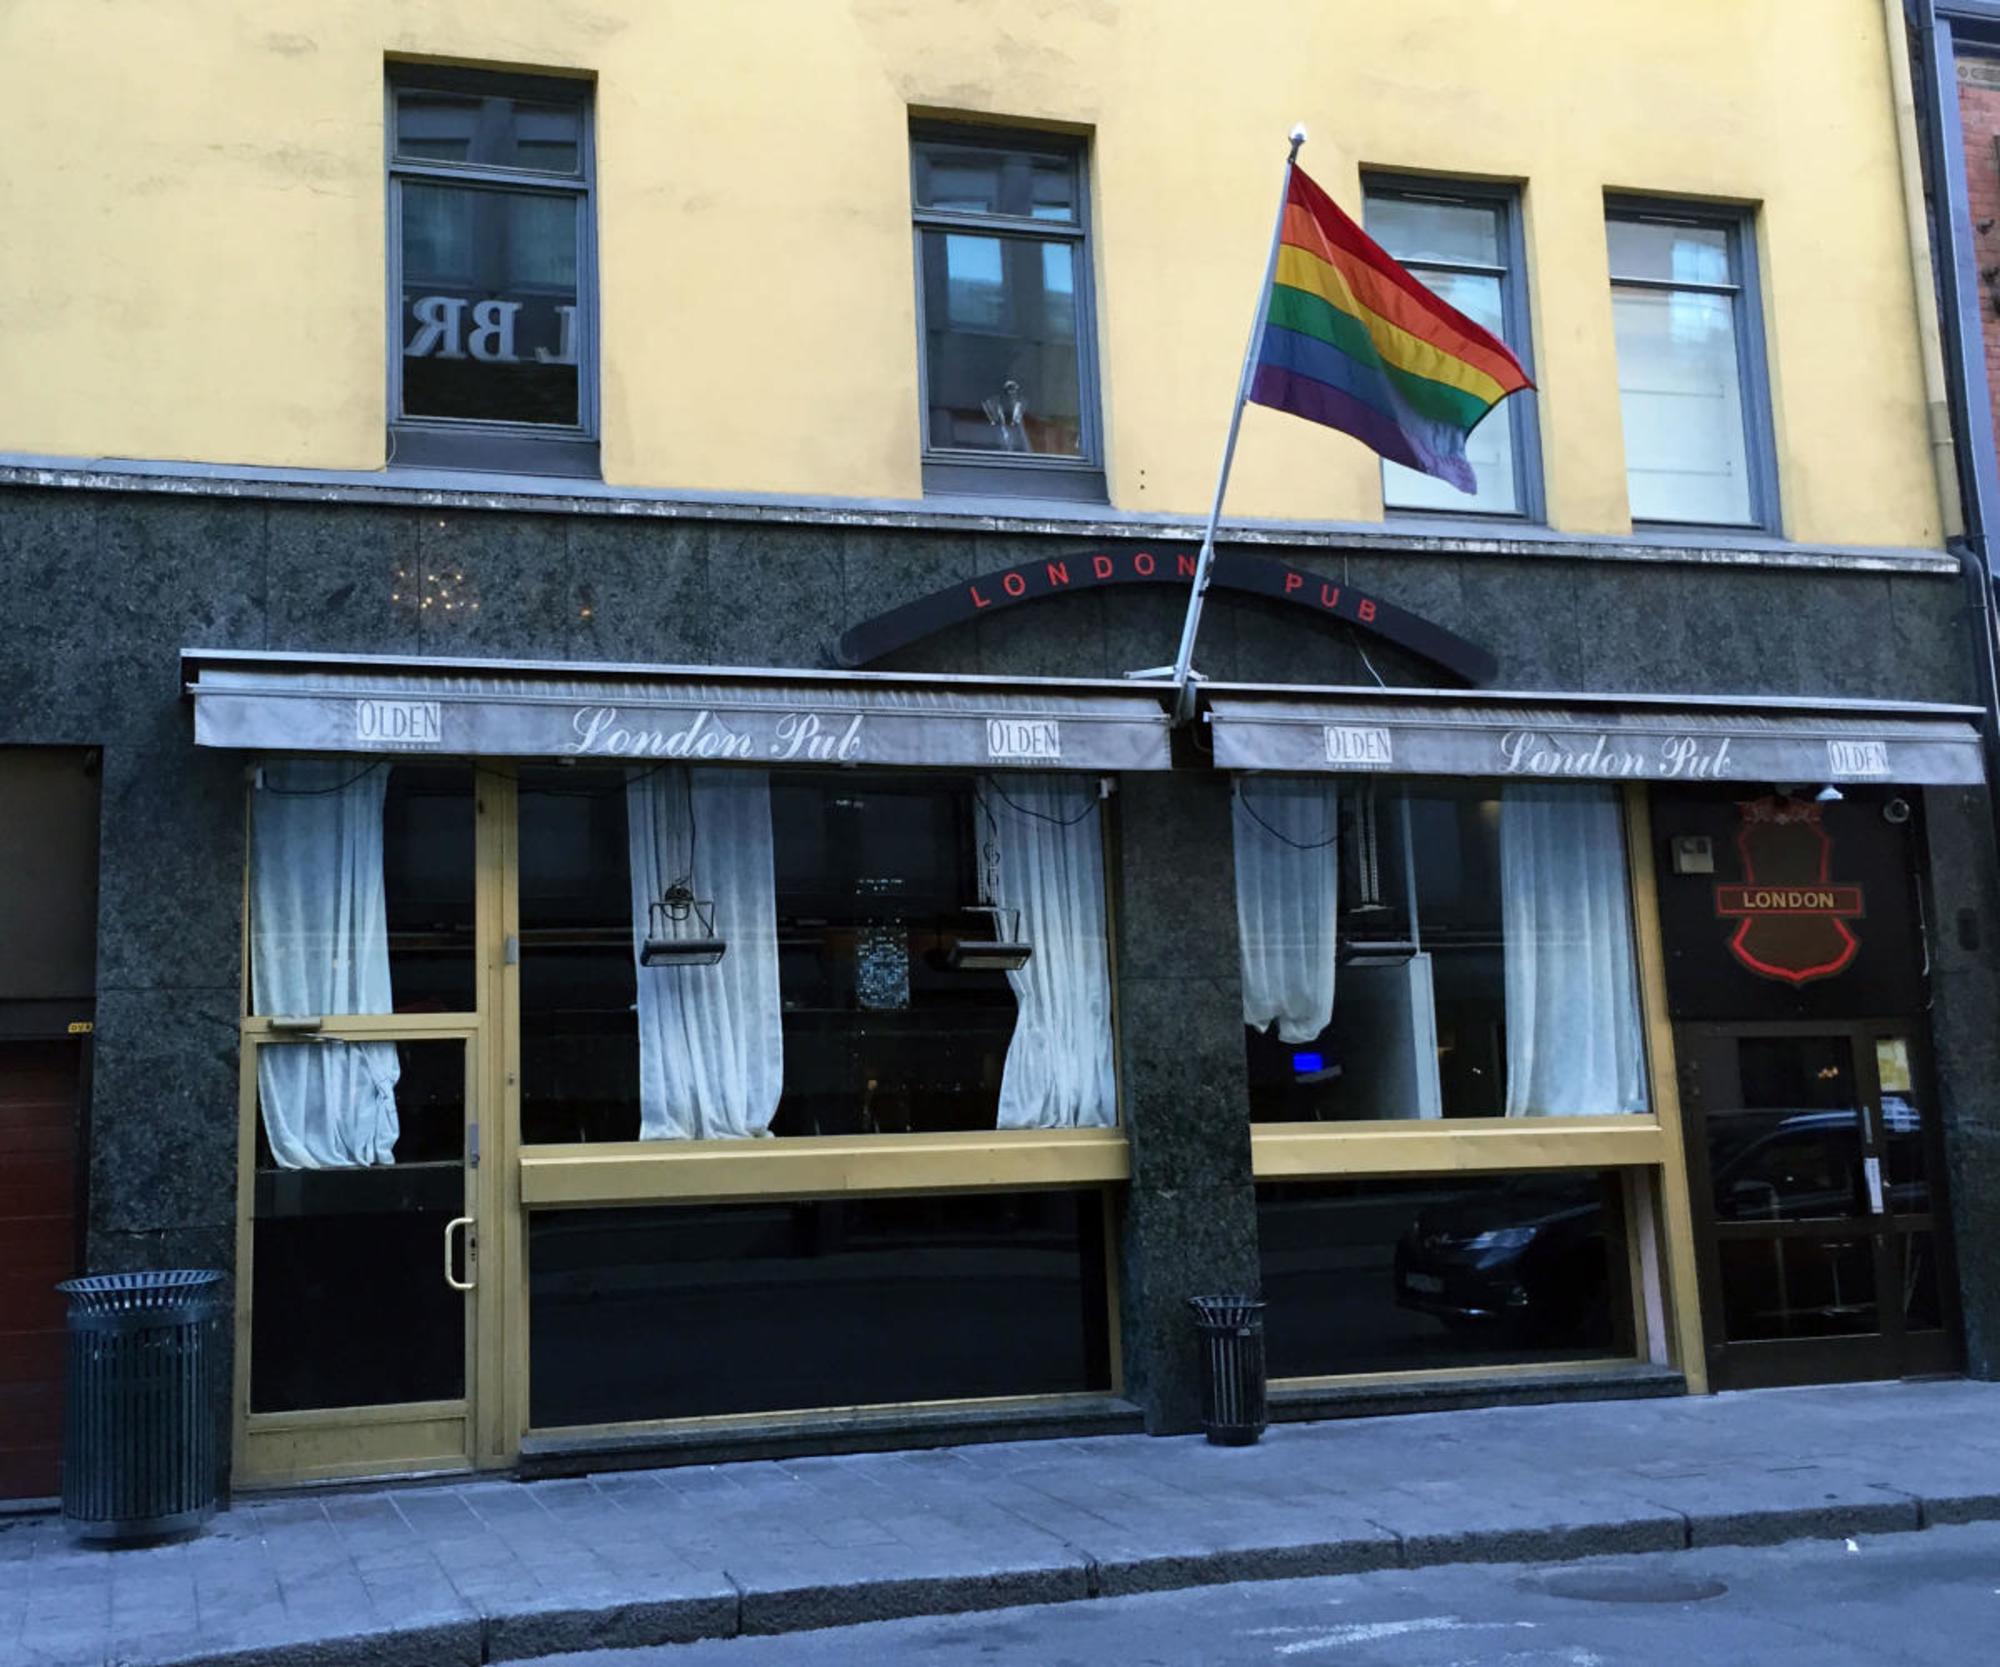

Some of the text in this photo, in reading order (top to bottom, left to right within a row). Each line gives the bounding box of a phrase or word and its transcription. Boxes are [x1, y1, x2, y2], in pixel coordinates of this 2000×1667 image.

[969, 552, 1377, 623] LONDON PUB
[360, 700, 438, 738] OLDEN
[563, 706, 864, 760] London Pub
[989, 720, 1057, 754] OLDEN
[1327, 727, 1390, 759] OLDEN
[1499, 731, 1731, 778] London Pub
[1743, 891, 1835, 908] LONDON
